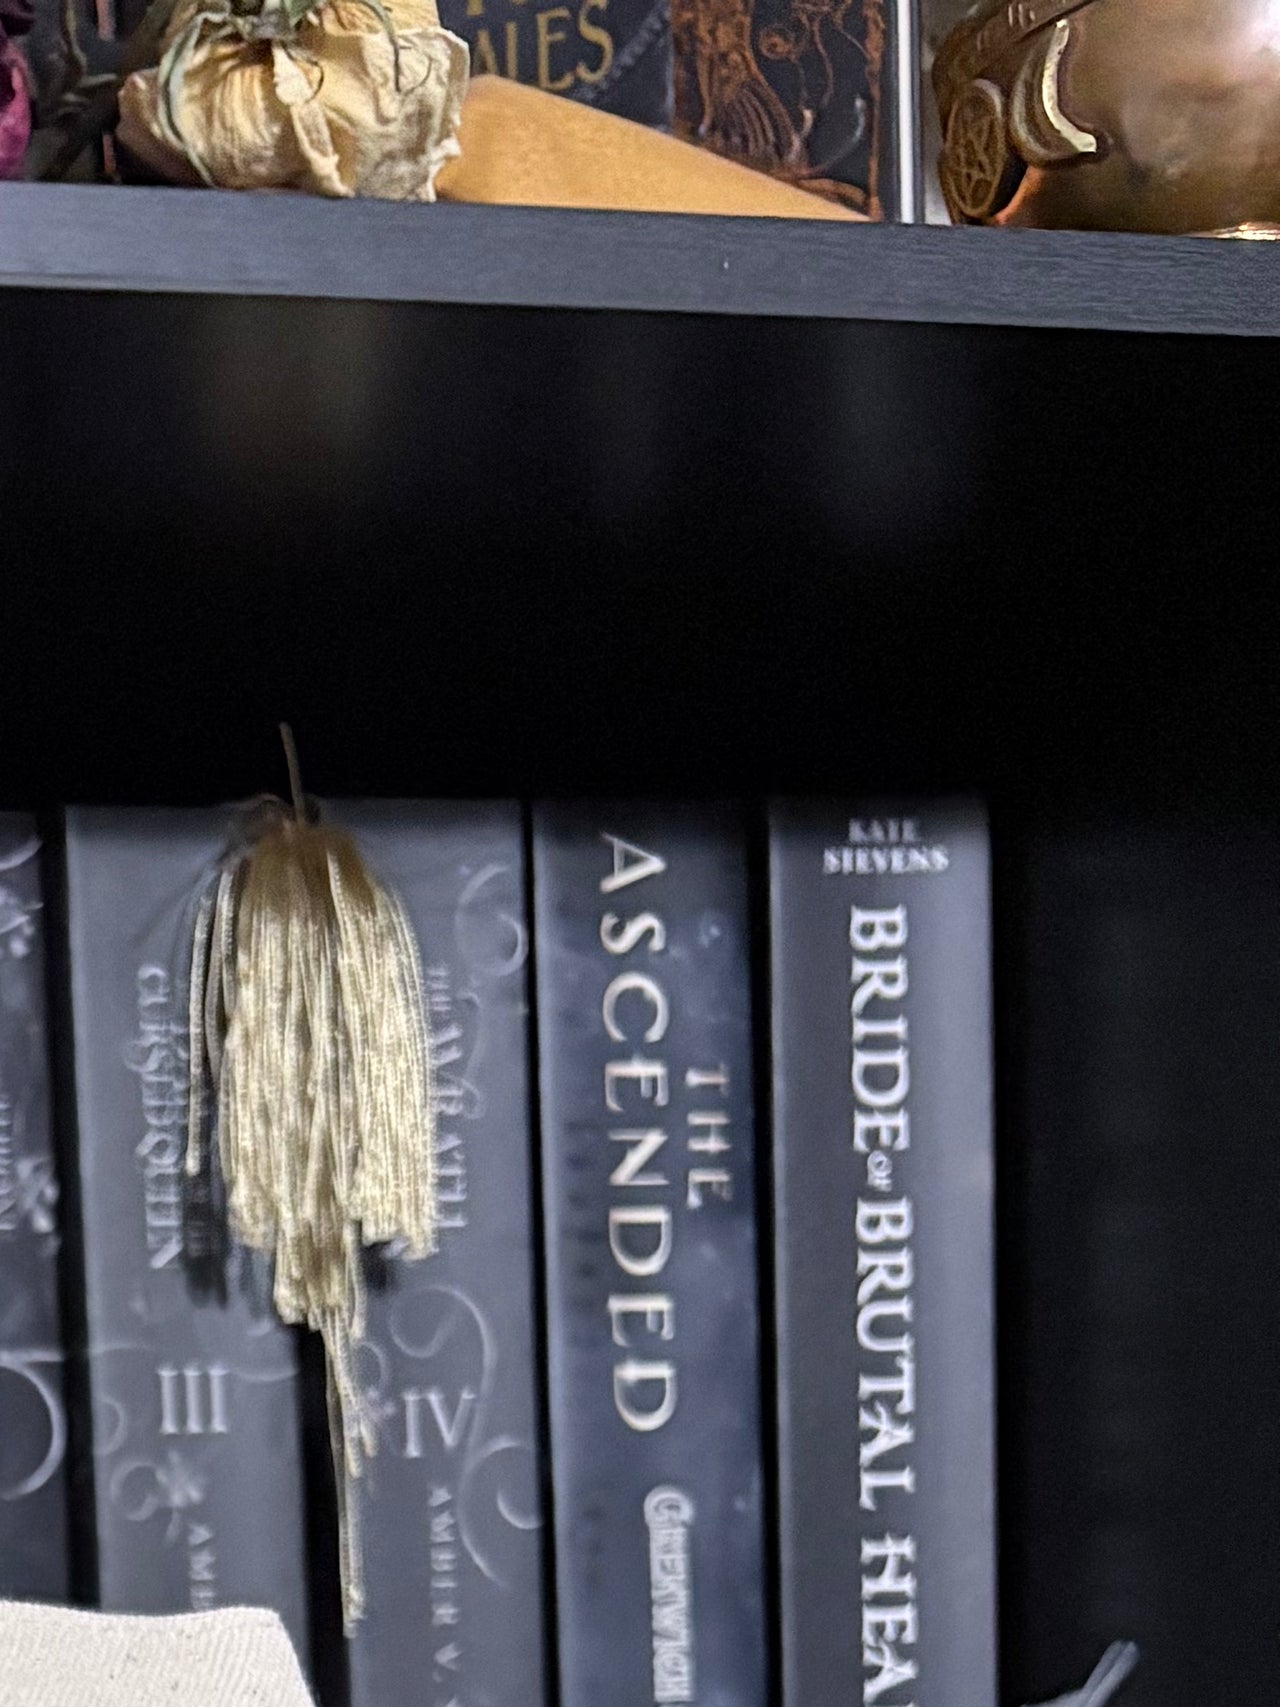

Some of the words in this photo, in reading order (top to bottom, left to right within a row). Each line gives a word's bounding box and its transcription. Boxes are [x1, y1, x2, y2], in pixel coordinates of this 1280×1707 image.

[823, 846, 950, 876] STEVENS
[847, 817, 921, 844] KATE
[848, 903, 911, 1154] BRIDE
[599, 829, 678, 1432] ASCENDED
[684, 1060, 732, 1209] THE
[157, 1362, 230, 1435] III
[854, 1195, 917, 1512] BRUTAL
